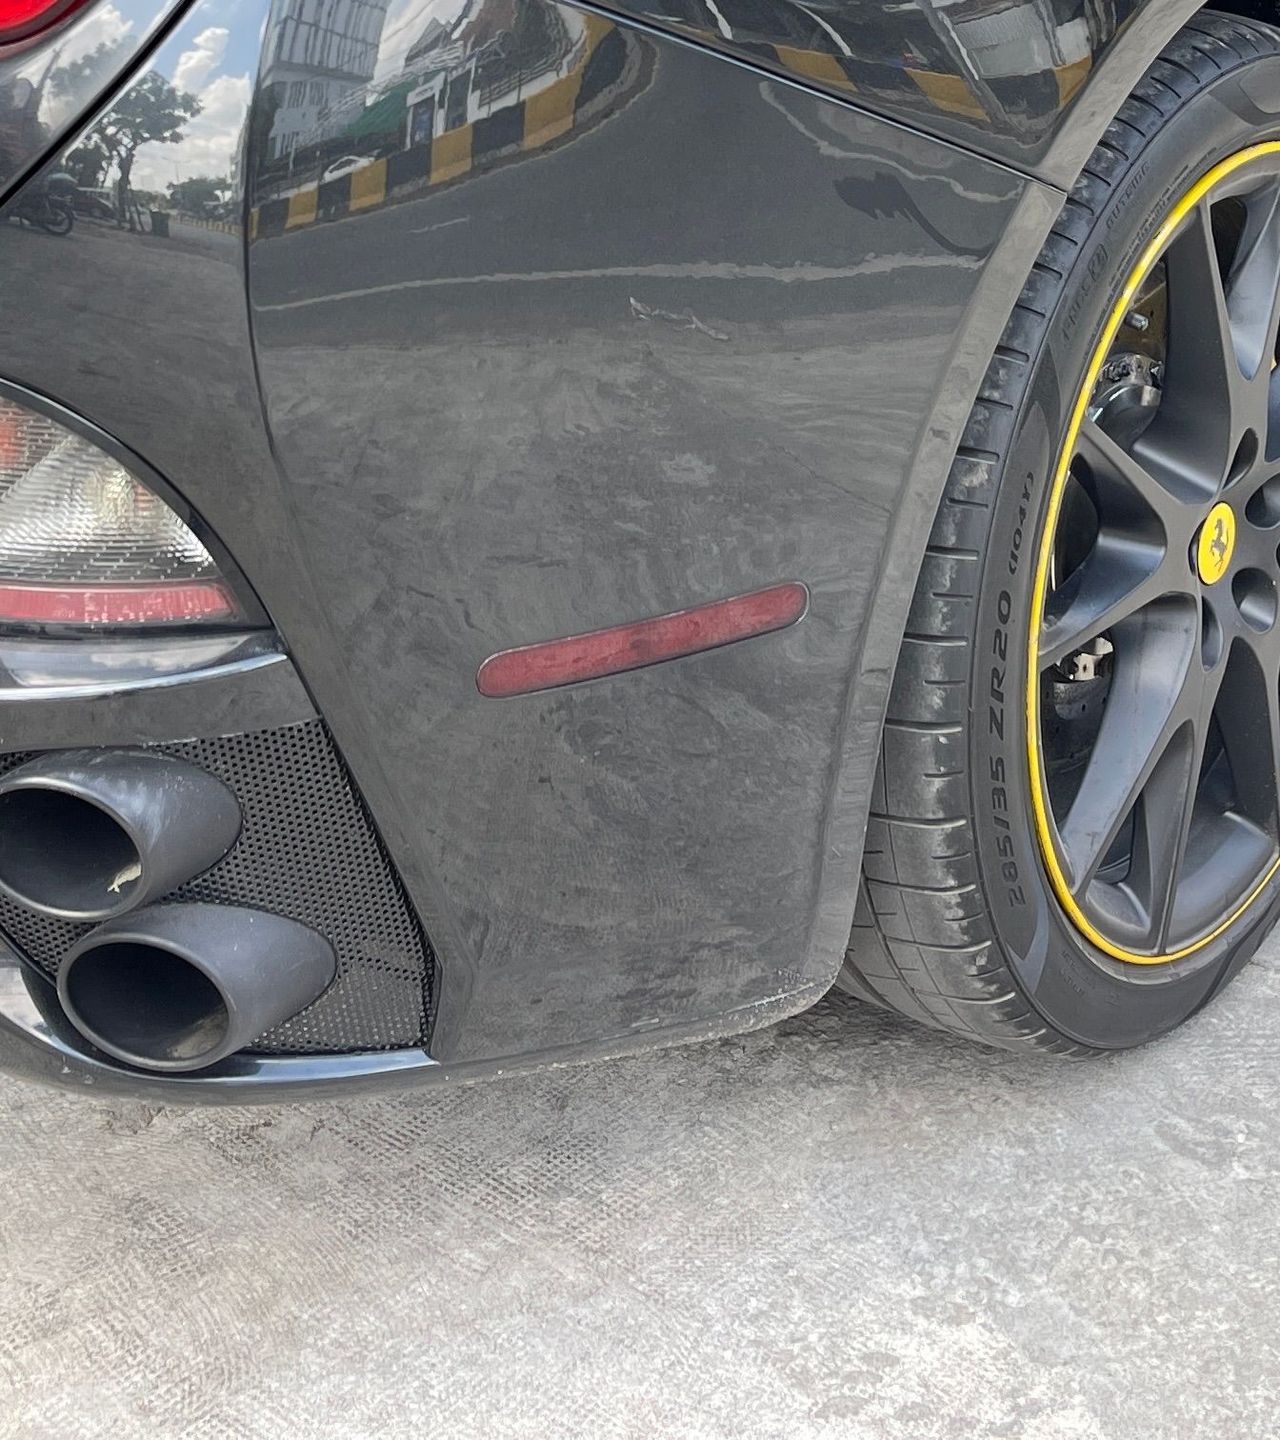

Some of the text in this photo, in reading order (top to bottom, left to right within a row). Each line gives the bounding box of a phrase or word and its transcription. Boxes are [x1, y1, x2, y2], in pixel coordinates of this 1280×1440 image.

[988, 471, 1035, 908] 285/35 ZR20 (104Y)
